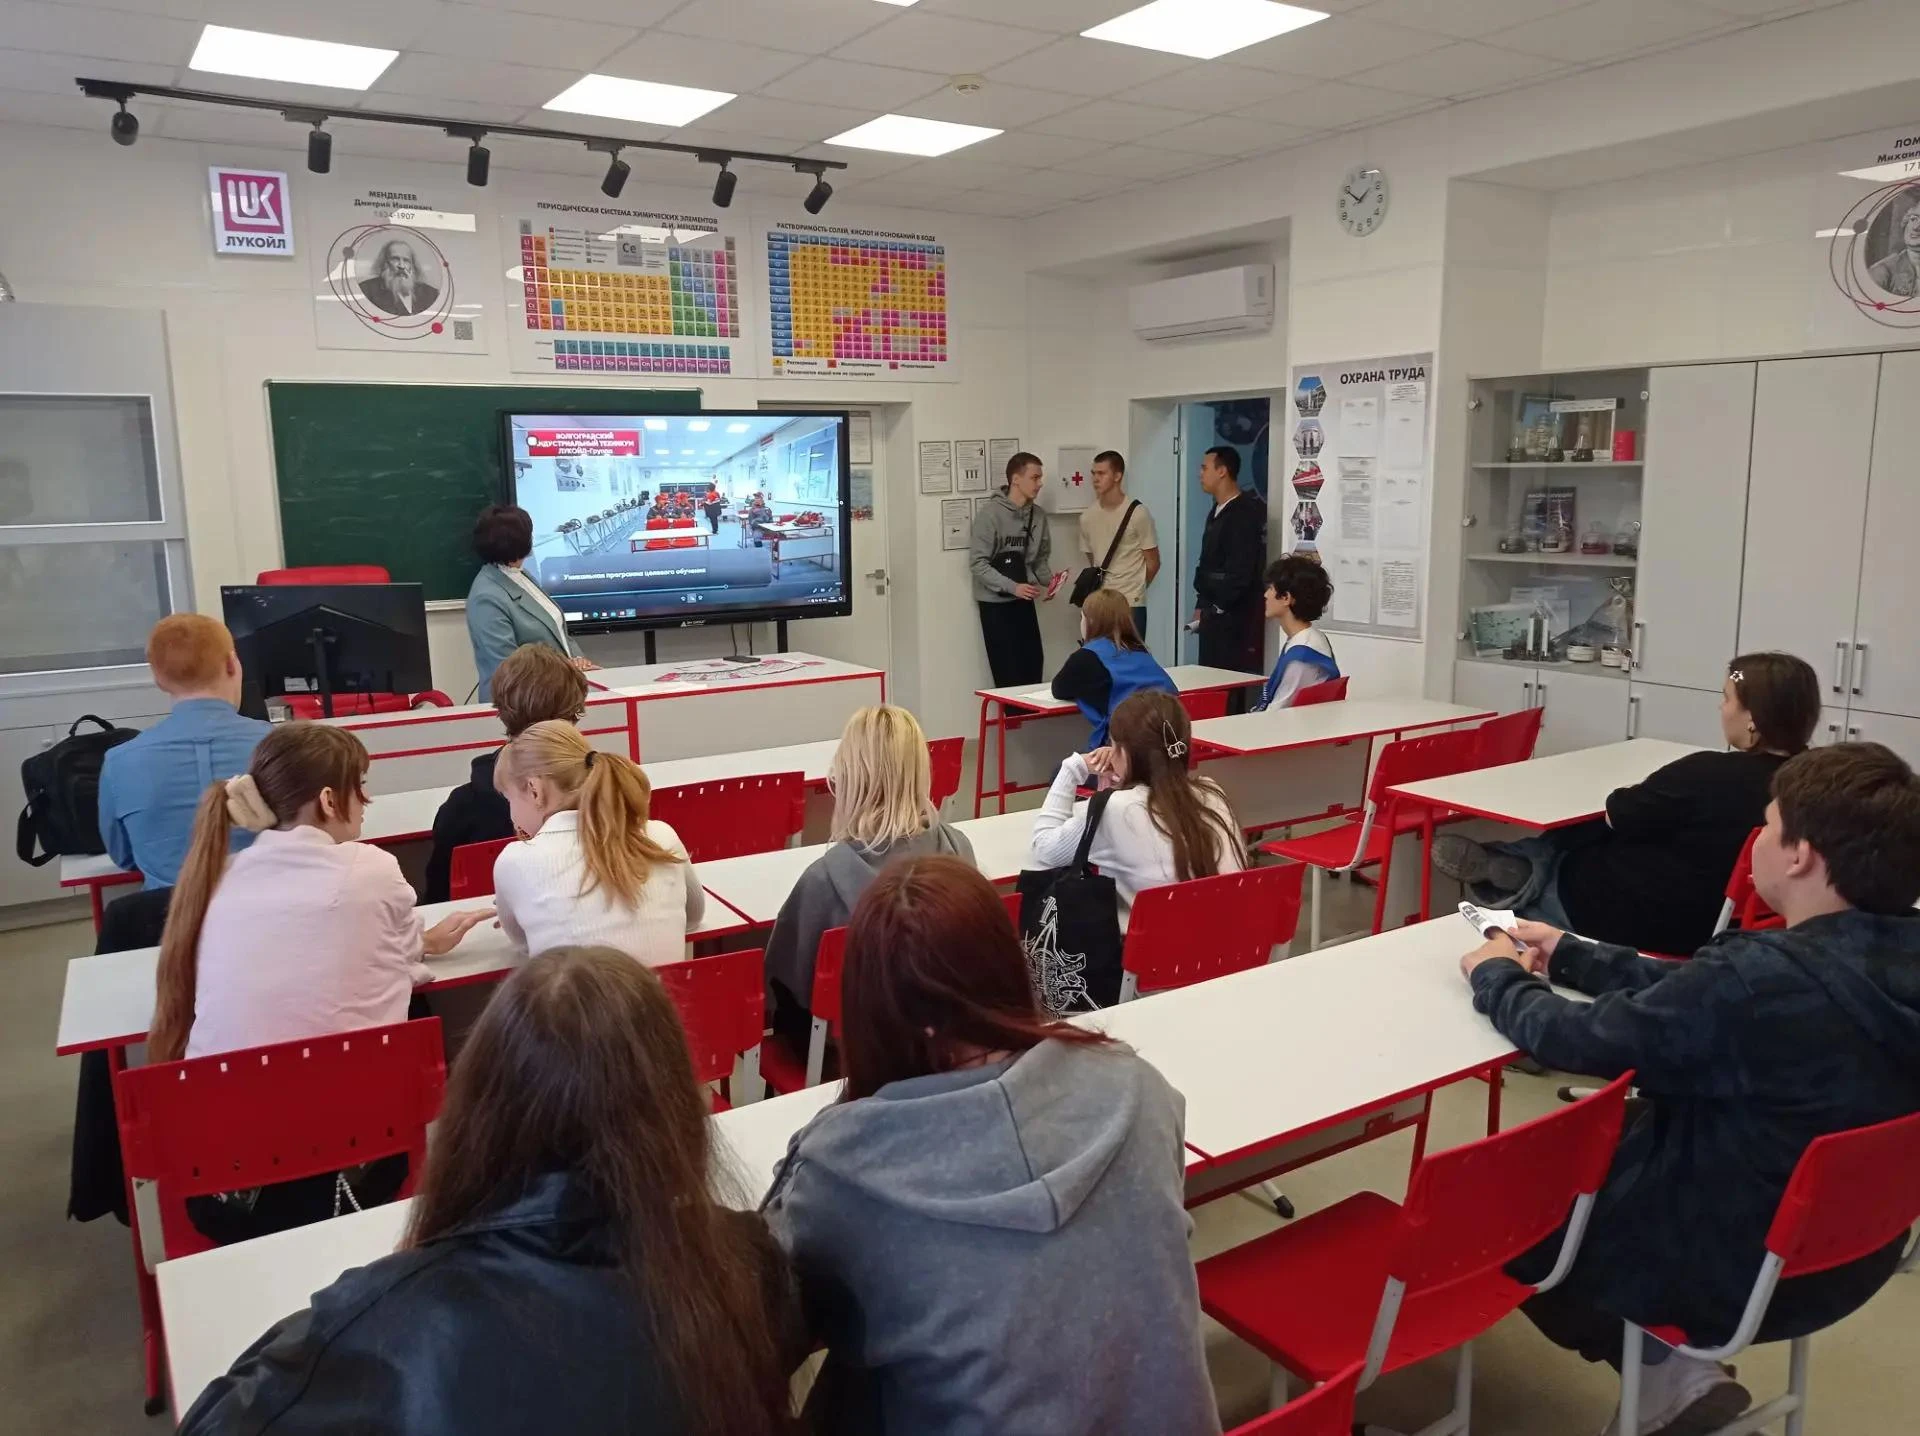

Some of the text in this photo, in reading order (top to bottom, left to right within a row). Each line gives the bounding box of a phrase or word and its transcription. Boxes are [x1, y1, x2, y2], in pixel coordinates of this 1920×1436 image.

[368, 190, 417, 201] МЕНДЕЛЕЕВ
[354, 198, 391, 209] Дмитрий
[537, 201, 718, 225] ПЕРИОДИЧЕСКАЯ СИСТЕМА ХИМИЧЕСКИХ ЭЛЕМЕНТОВ
[677, 223, 719, 233] МЕНДЕЛЕЕВА
[776, 222, 828, 233] РАСТВОРИМОСТЬ
[850, 228, 874, 237] КИСЛОТ
[879, 229, 916, 240] ОСНОВАНИЙ
[921, 234, 936, 242] ВОДЕ
[225, 236, 286, 249] ЛУКОЙЛ
[622, 242, 637, 254] Ce
[1340, 366, 1426, 385] ОХРАНА ТРУДА
[555, 431, 615, 440] ВОЛГОГРАДСКИЙ
[537, 439, 599, 448] НДУСТРИАЛЬНЫЙ
[563, 567, 706, 581] Уникальная программа целевого обучения
